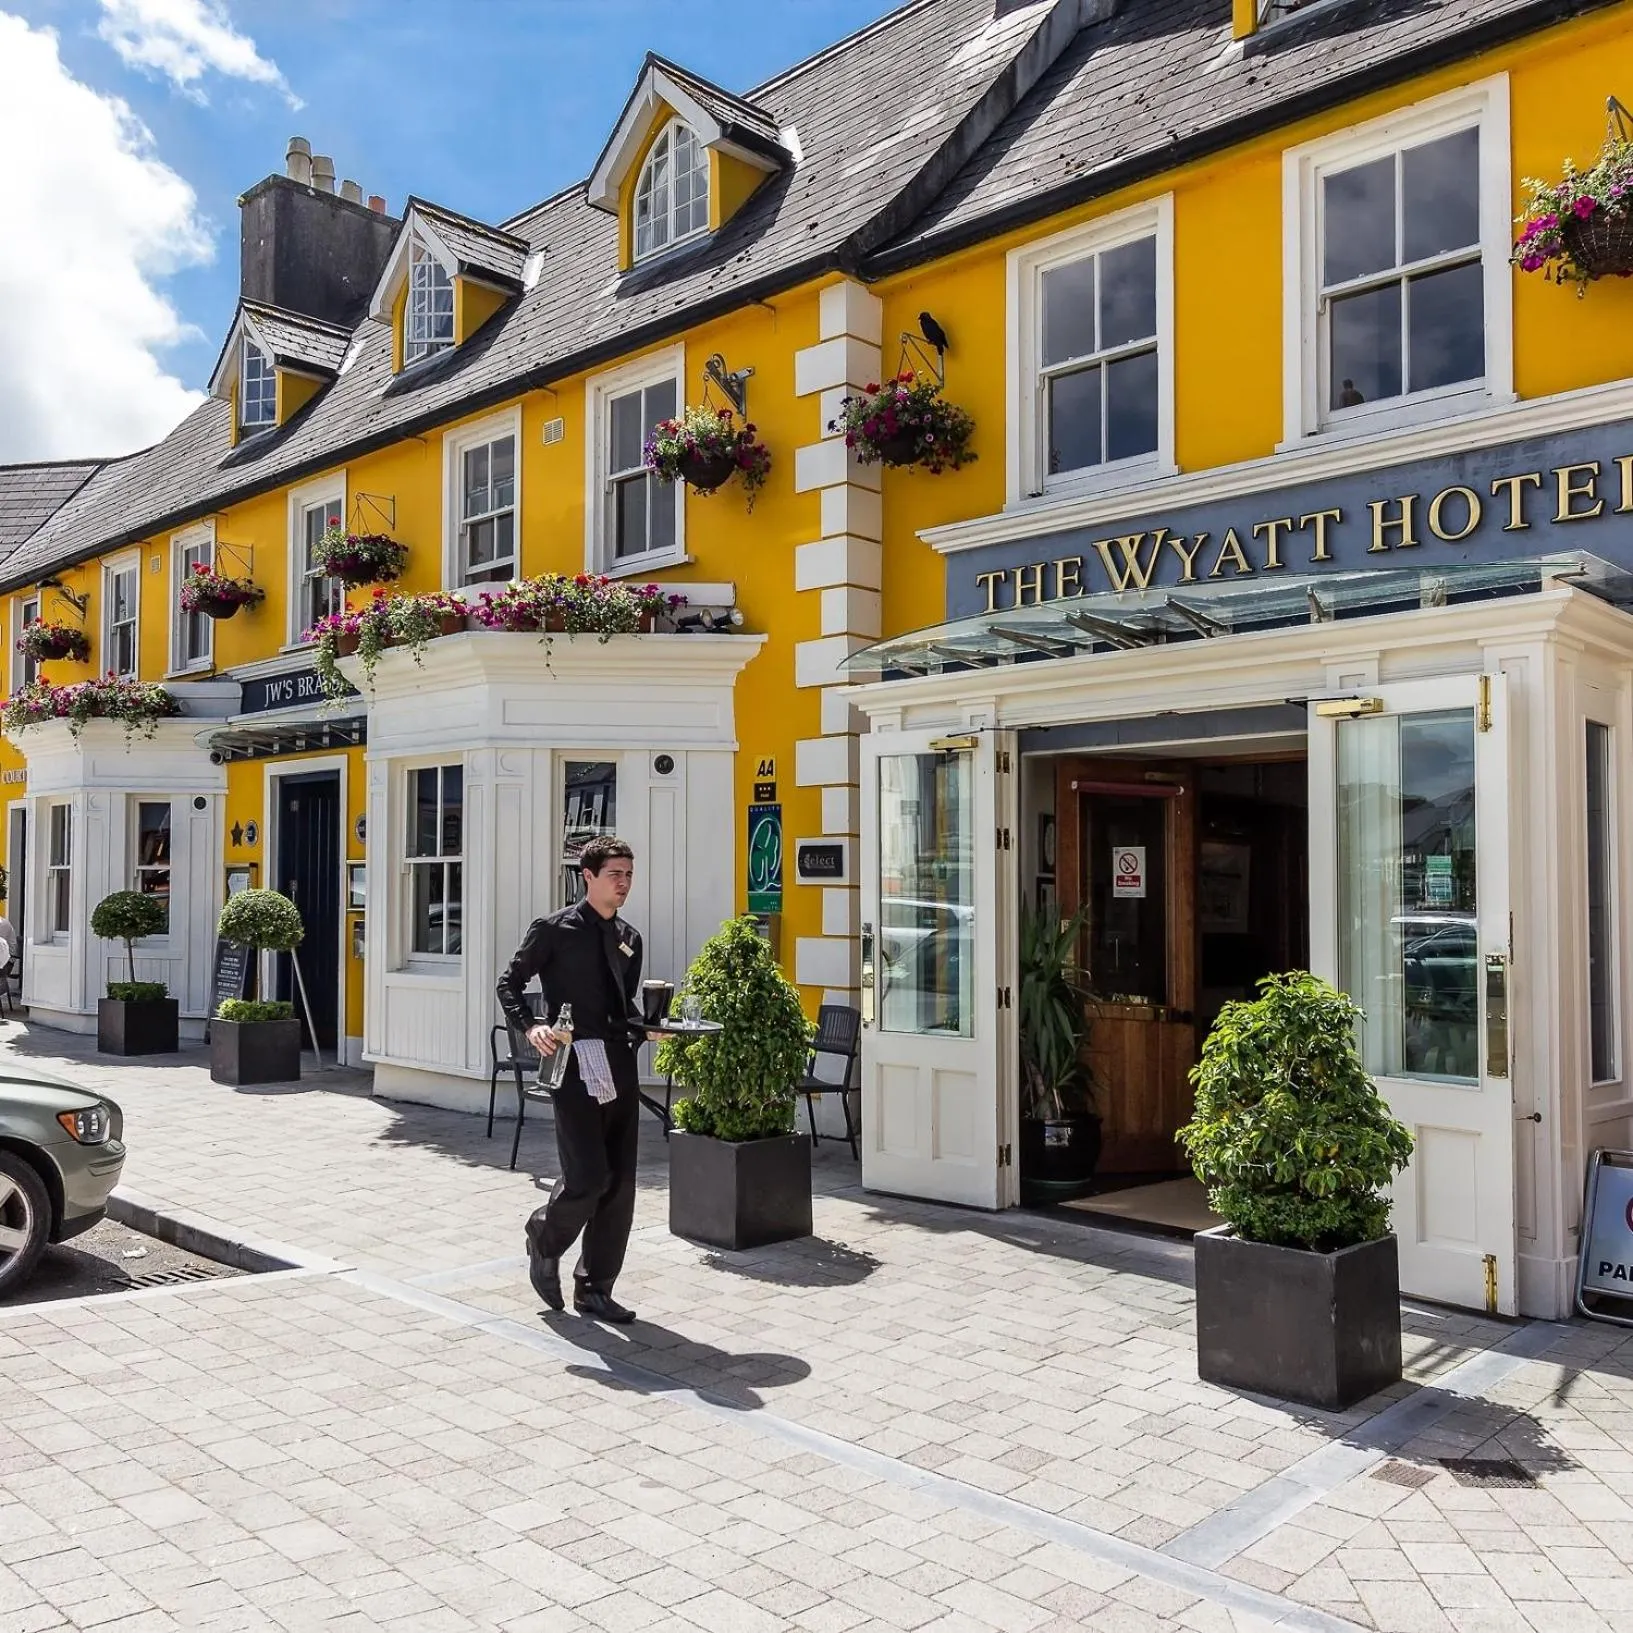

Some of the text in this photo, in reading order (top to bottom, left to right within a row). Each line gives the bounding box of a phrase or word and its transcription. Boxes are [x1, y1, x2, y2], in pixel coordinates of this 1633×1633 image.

[975, 555, 1084, 614] THE
[1092, 507, 1342, 600] WYATT
[264, 680, 293, 707] JW'S
[757, 759, 774, 776] AA
[1598, 1261, 1633, 1282] PA
